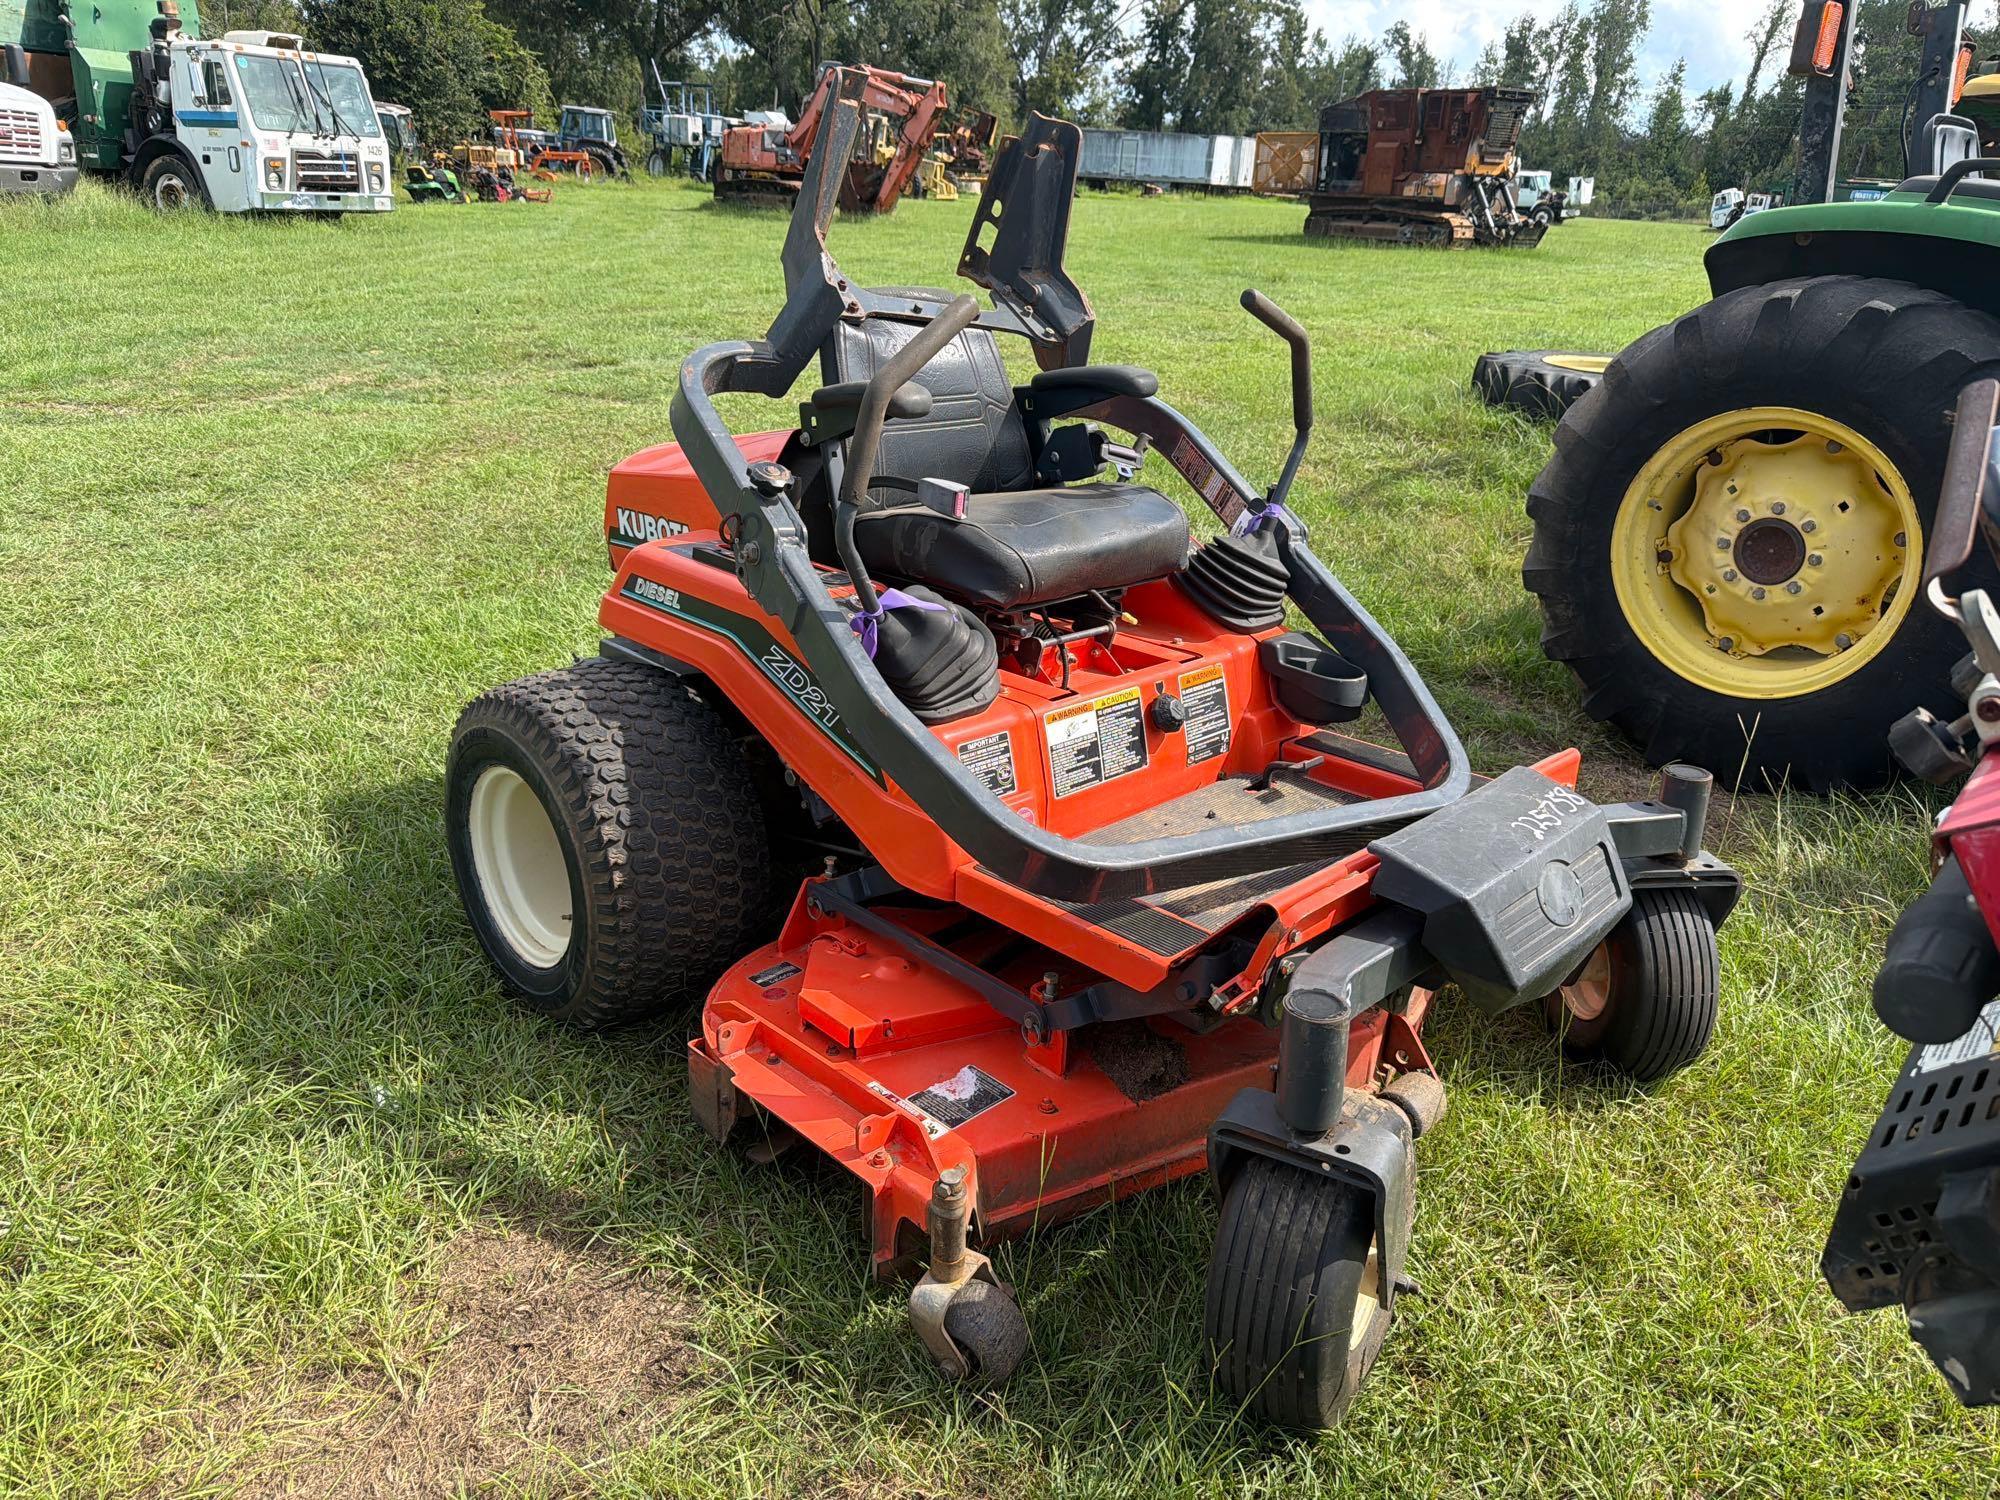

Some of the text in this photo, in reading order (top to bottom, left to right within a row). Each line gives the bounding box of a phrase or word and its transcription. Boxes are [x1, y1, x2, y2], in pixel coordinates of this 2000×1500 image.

[635, 577, 681, 610] DIESEL
[1191, 668, 1217, 682] WARNING
[761, 644, 840, 727] ZD21
[1106, 691, 1134, 705] CAUTION
[1057, 704, 1088, 719] WARNING
[967, 735, 1000, 750] IMPORTANT
[1511, 786, 1586, 840] 225758
